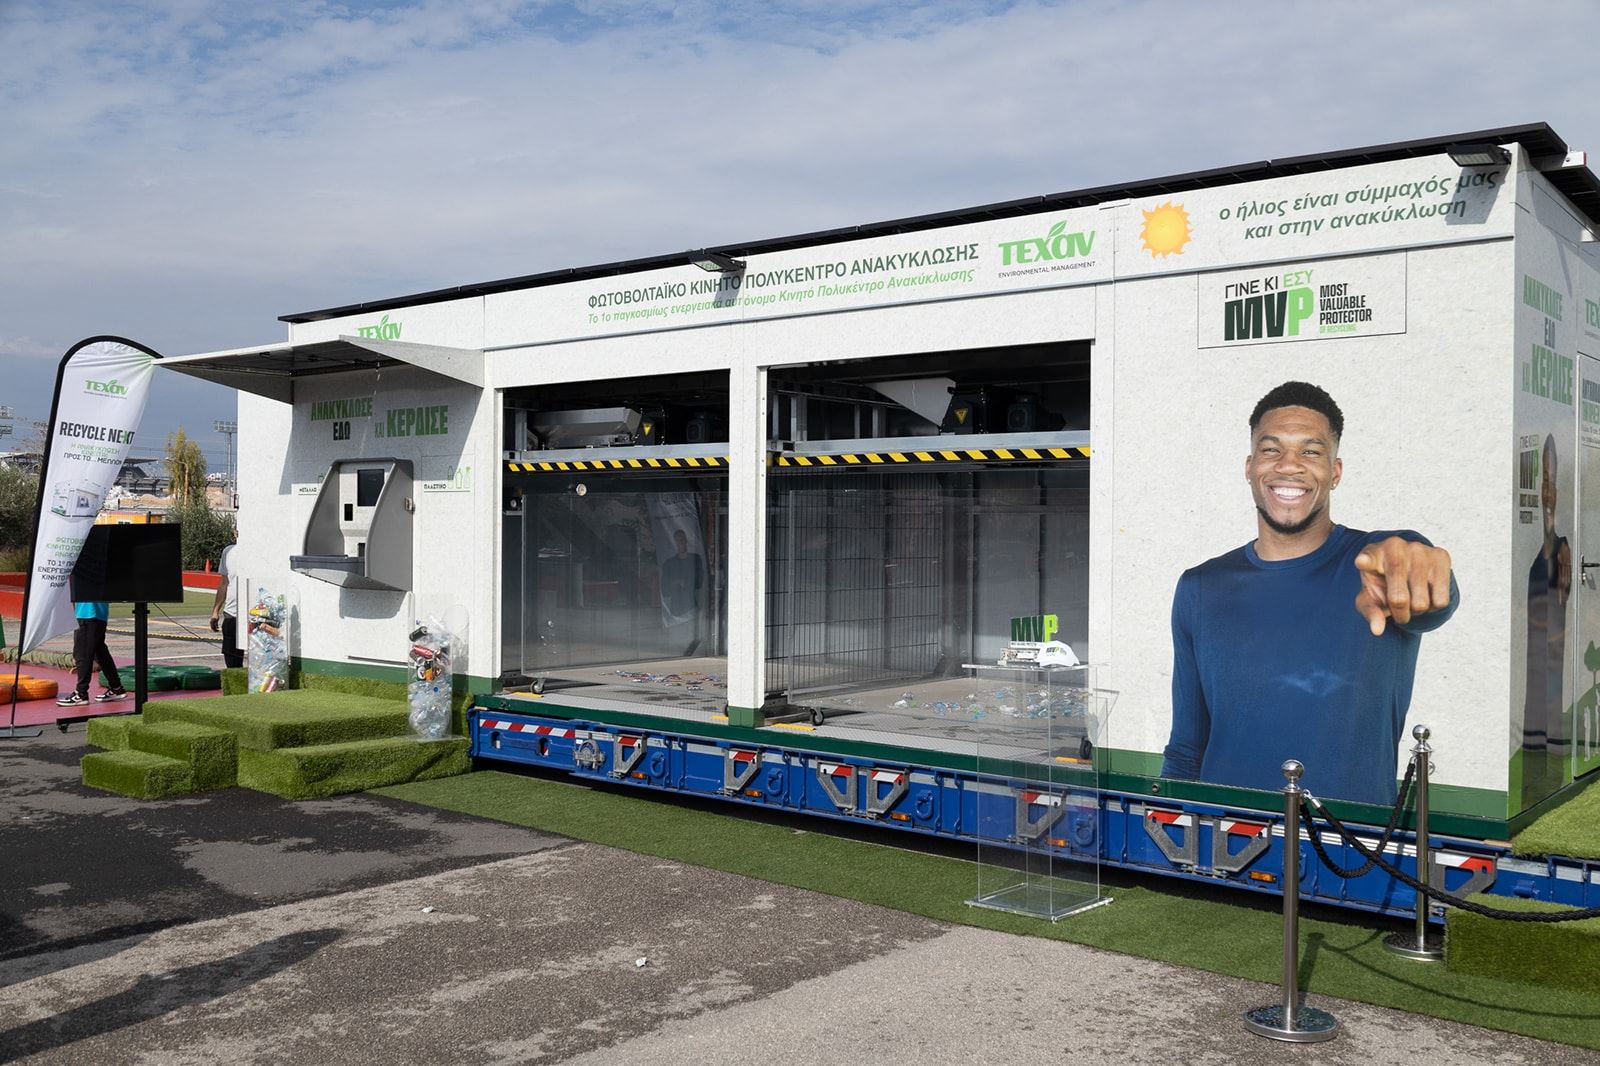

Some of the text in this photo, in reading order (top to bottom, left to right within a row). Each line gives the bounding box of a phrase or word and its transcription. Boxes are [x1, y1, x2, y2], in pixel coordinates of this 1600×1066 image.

[1219, 170, 1500, 221] ο ήλιος είναι σύμμαχός μας
[1245, 199, 1466, 240] και στην ανακύκλωση
[588, 243, 979, 308] ΦΩΤΟΒΟΛΤΑΪΚΟ ΚΙΝΗΤΟ ΠΟΛΥΚΕΝΤΡΟ ΑΝΑΚΥΚΛΩΣΗΣ
[998, 261, 1096, 278] ENVIRONMENTAL MANAGEMENT
[614, 306, 668, 321] παγκοσμίως
[670, 299, 722, 316] ενεργειακά
[779, 286, 814, 302] Κινητό
[817, 279, 884, 297] Πολυκέντρο
[887, 268, 975, 289] Ανακύκλωσης
[1225, 270, 1314, 299] ΓΙΝΕ ΚΙ ΕΣΥ
[1320, 283, 1348, 298] MOST
[1224, 287, 1314, 341] MVP
[1320, 295, 1366, 311] VALUABLE
[1320, 308, 1372, 325] PROTECTOR
[310, 397, 373, 421] ΑΝΑΚΥΚΛΩΣΕ
[387, 405, 449, 438] ΚΕΡΔΙΣΕ
[60, 421, 136, 445] RECYCLE NEXT
[333, 421, 350, 440] ΕΔΩ
[1010, 614, 1058, 642] MVP
